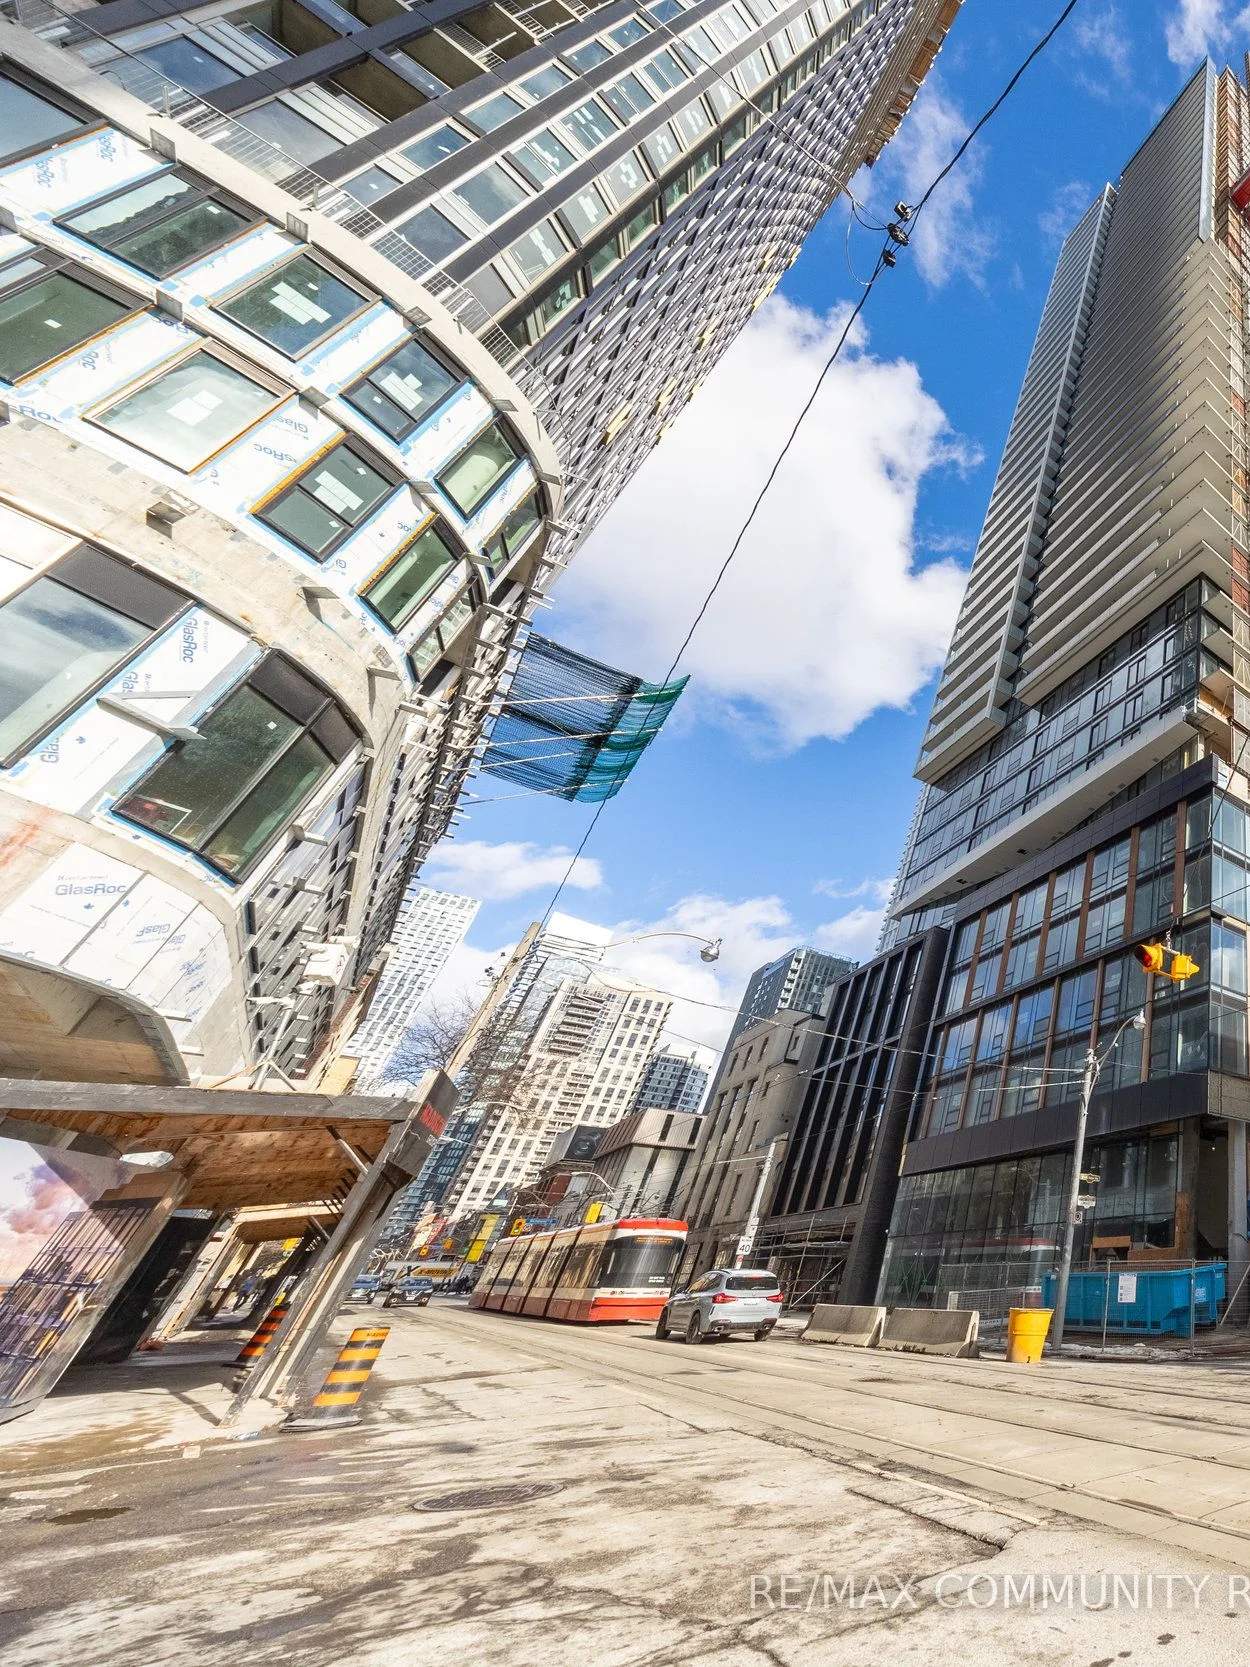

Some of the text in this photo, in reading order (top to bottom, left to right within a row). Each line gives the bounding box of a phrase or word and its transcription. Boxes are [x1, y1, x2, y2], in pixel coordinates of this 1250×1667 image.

[182, 617, 198, 663] GlasRoc
[55, 884, 127, 896] GlasRoc
[739, 1244, 751, 1253] 40
